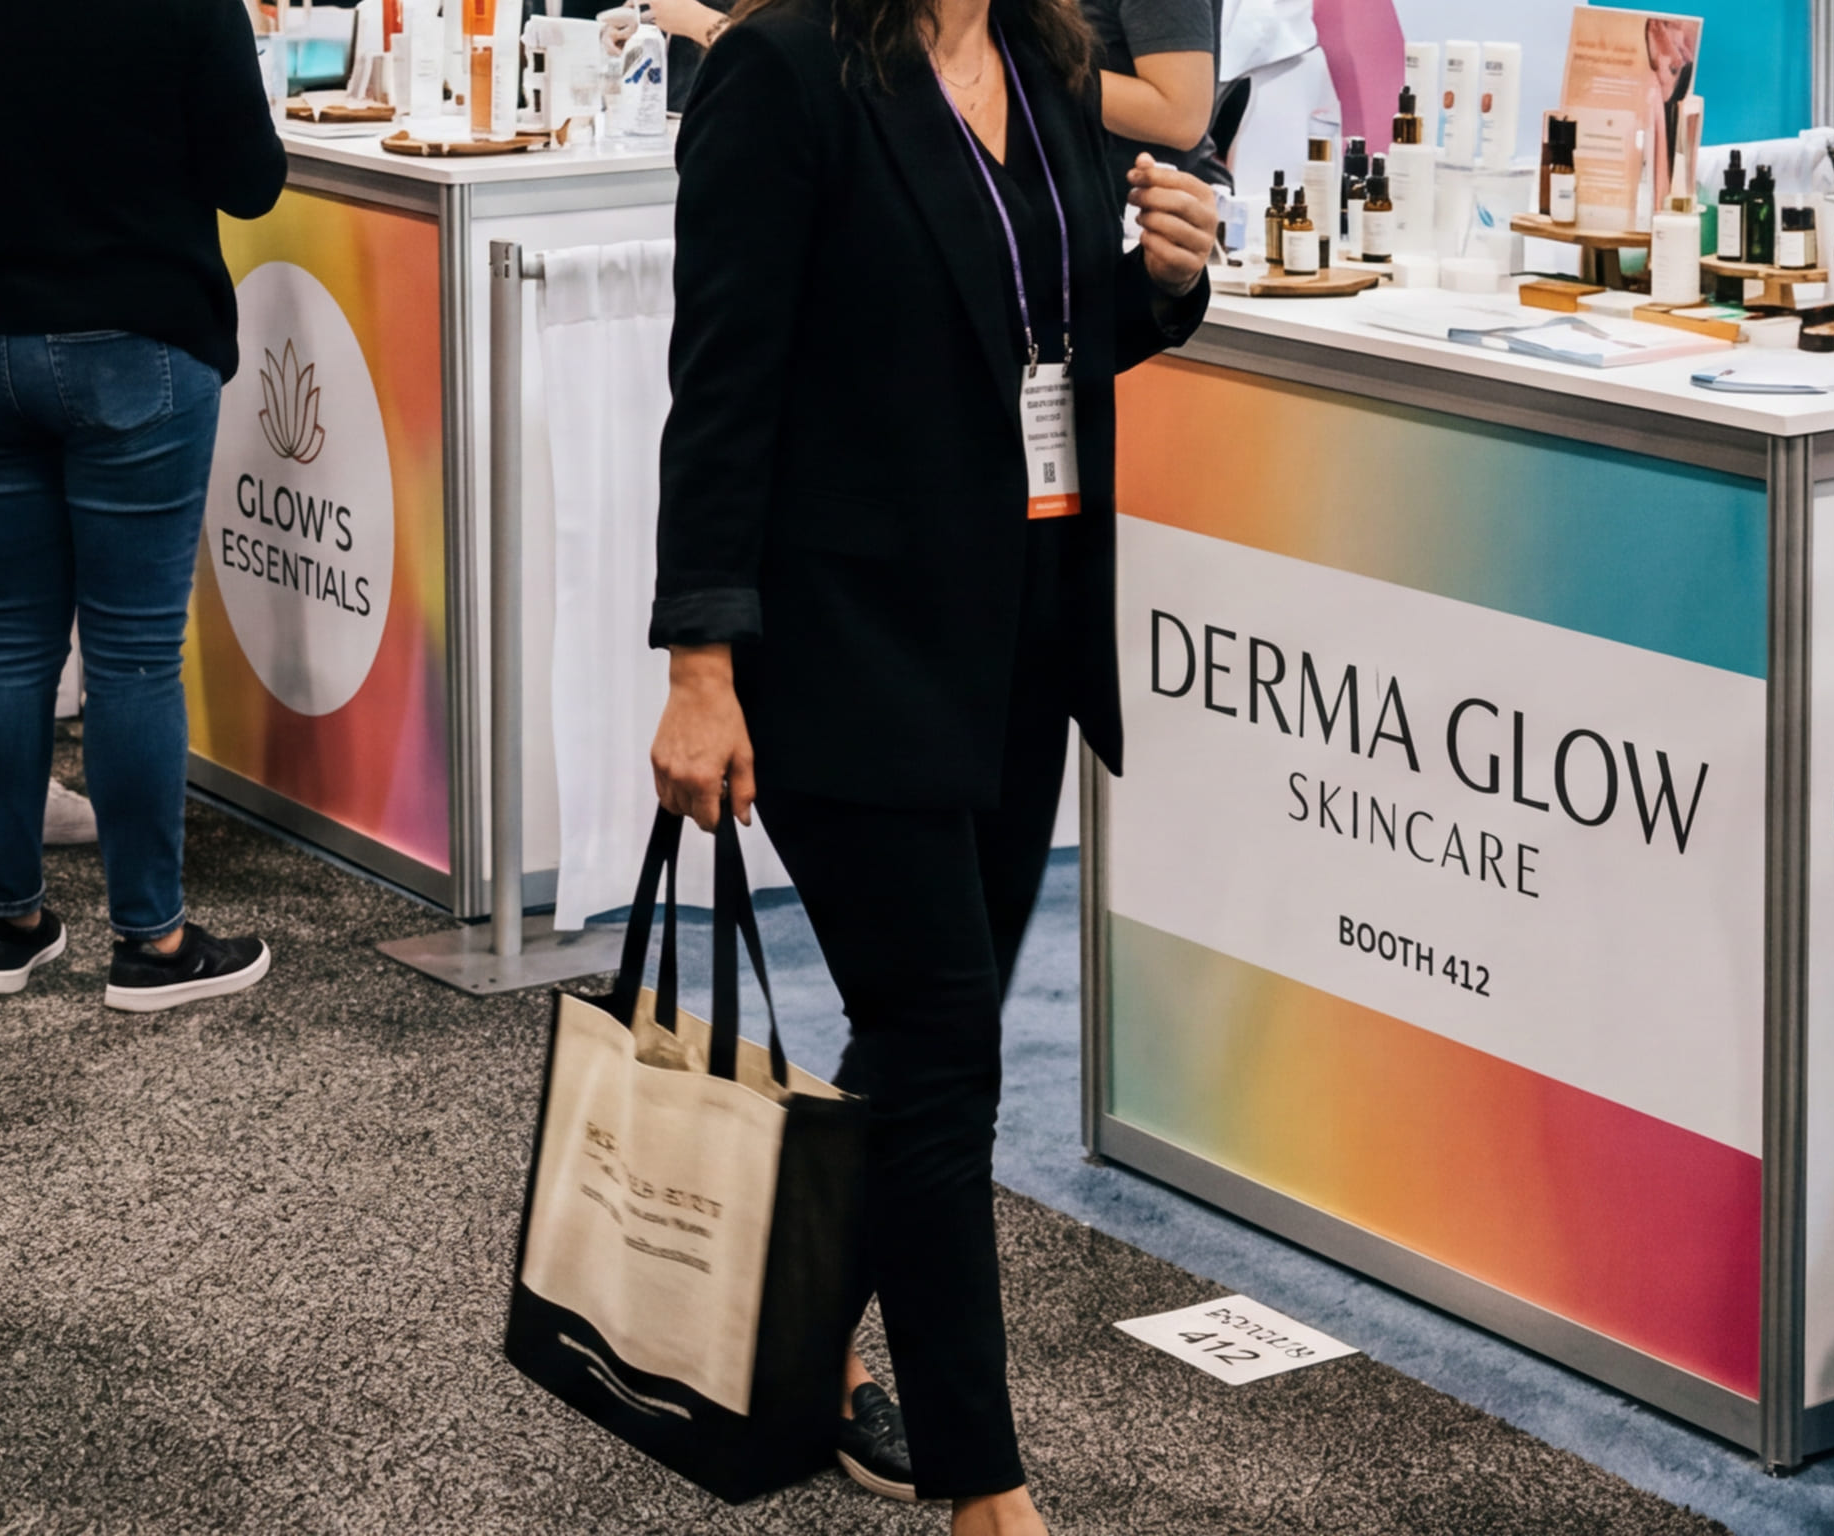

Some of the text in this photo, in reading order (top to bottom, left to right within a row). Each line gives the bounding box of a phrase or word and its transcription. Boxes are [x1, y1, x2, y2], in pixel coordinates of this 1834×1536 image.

[236, 473, 353, 552] GLOW'S
[222, 528, 371, 617] ESSENTIALS
[1150, 608, 1710, 855] DERMA GLOW
[1287, 771, 1541, 899] SKINCARE
[1338, 914, 1491, 998] BOOTH 412
[1177, 1331, 1261, 1366] 412
